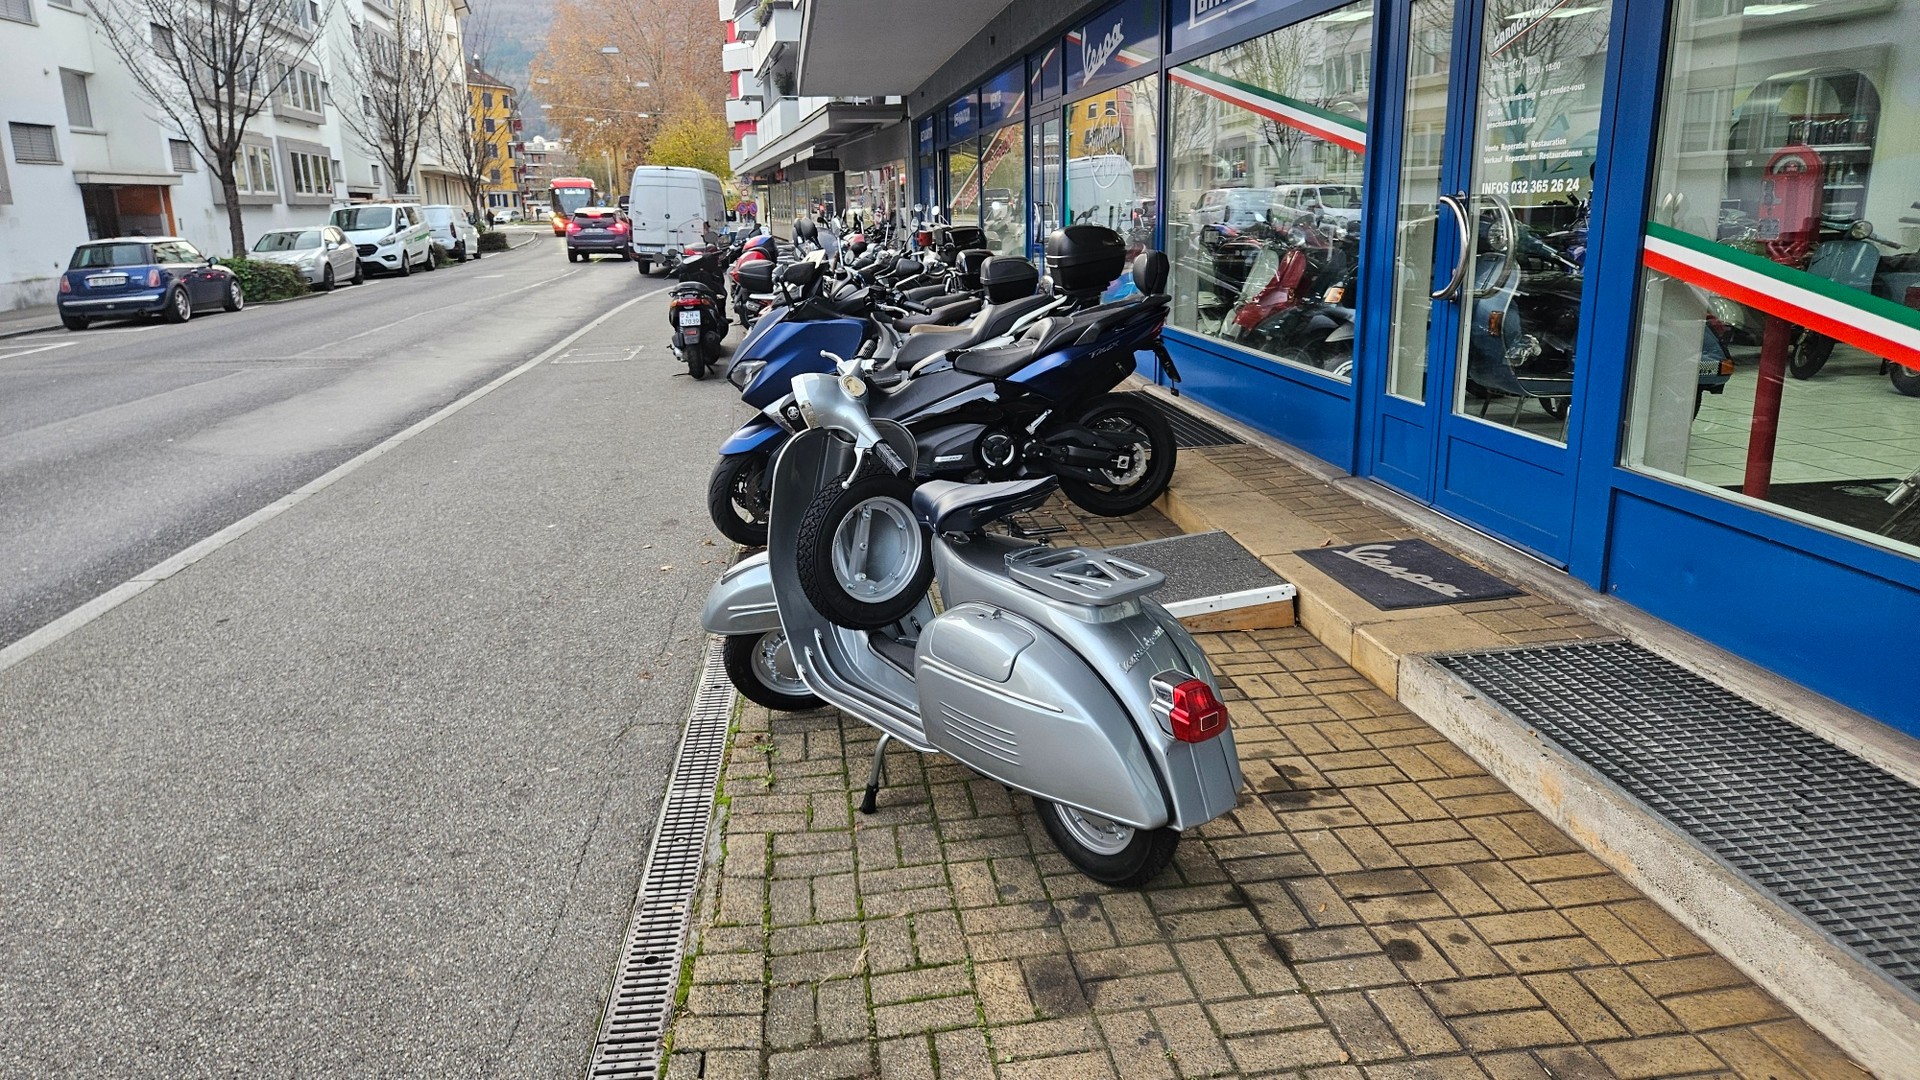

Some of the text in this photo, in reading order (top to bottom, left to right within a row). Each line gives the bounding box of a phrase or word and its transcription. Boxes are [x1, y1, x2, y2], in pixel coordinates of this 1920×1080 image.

[1494, 16, 1527, 48] GARAGE
[1082, 23, 1124, 87] Vespa
[1550, 83, 1586, 96] rendez-vous
[1484, 145, 1499, 153] Vente
[1530, 137, 1567, 148] Restauration
[1483, 149, 1583, 164] Verkauf Reparaturen Restaurationen
[1482, 177, 1580, 195] INFOS 032 365 26 24
[1332, 544, 1464, 598] Vespa
